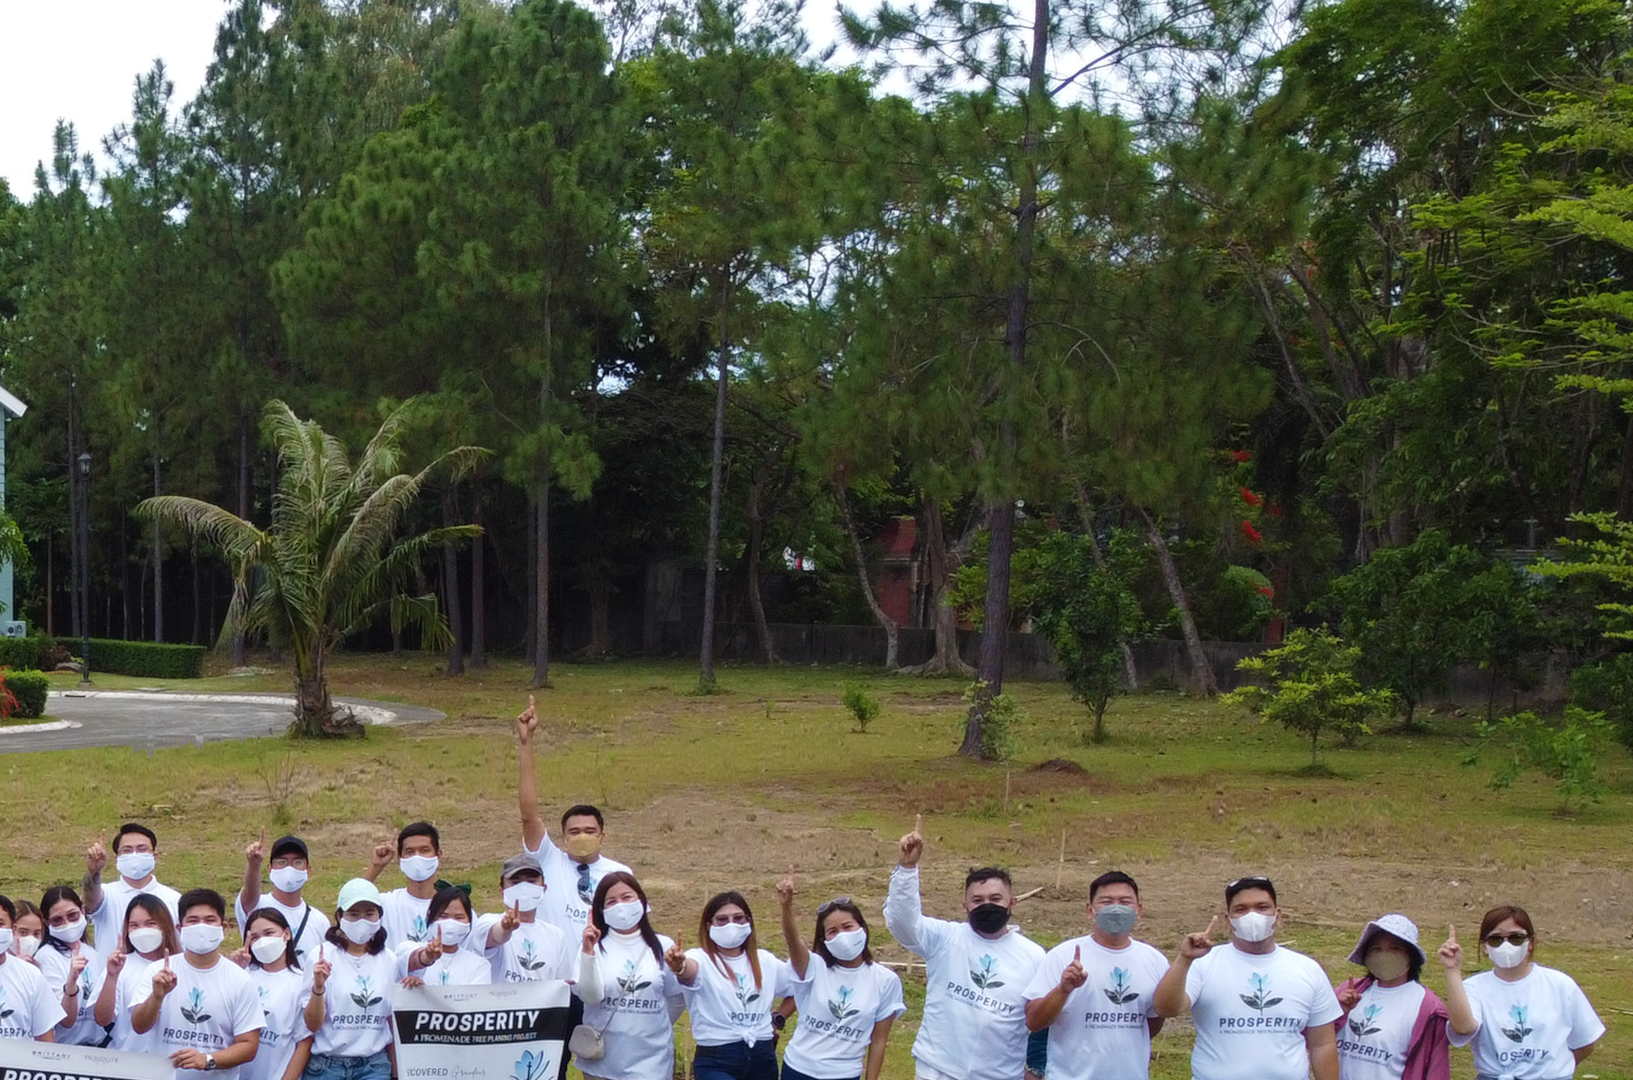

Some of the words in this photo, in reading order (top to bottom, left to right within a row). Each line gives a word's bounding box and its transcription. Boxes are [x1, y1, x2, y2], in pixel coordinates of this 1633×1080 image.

[947, 981, 1016, 1014] PROSPERITY
[415, 1010, 540, 1032] PROSPERITY
[1219, 1017, 1302, 1028] PROSPERITY
[413, 1034, 419, 1042] A
[420, 1033, 471, 1044] PROMENADE
[472, 1035, 487, 1043] TREE
